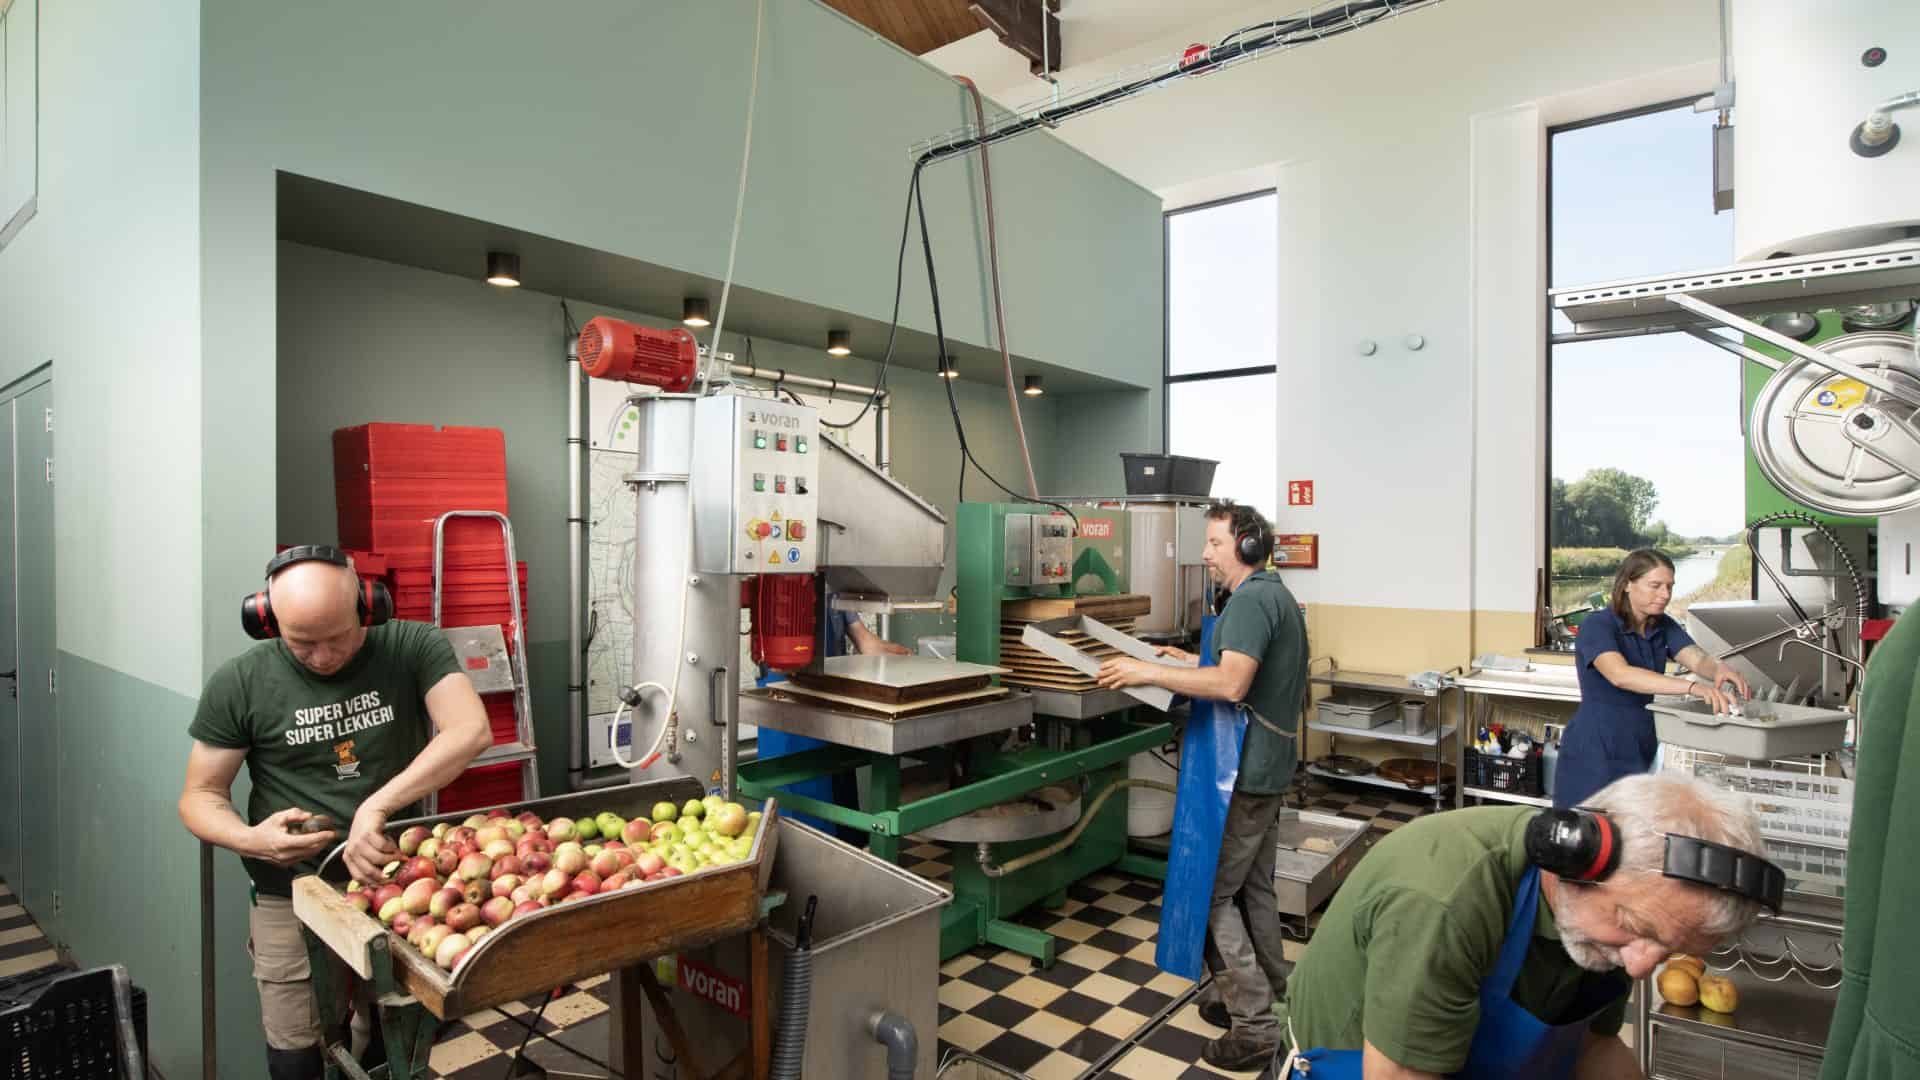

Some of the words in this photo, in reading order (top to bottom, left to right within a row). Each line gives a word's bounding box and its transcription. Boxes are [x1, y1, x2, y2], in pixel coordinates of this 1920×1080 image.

[760, 412, 800, 428] voran
[1082, 524, 1109, 537] voran
[295, 703, 343, 726] SUPER
[345, 690, 381, 715] VERS
[285, 723, 335, 746] SUPER
[684, 964, 741, 1012] voran
